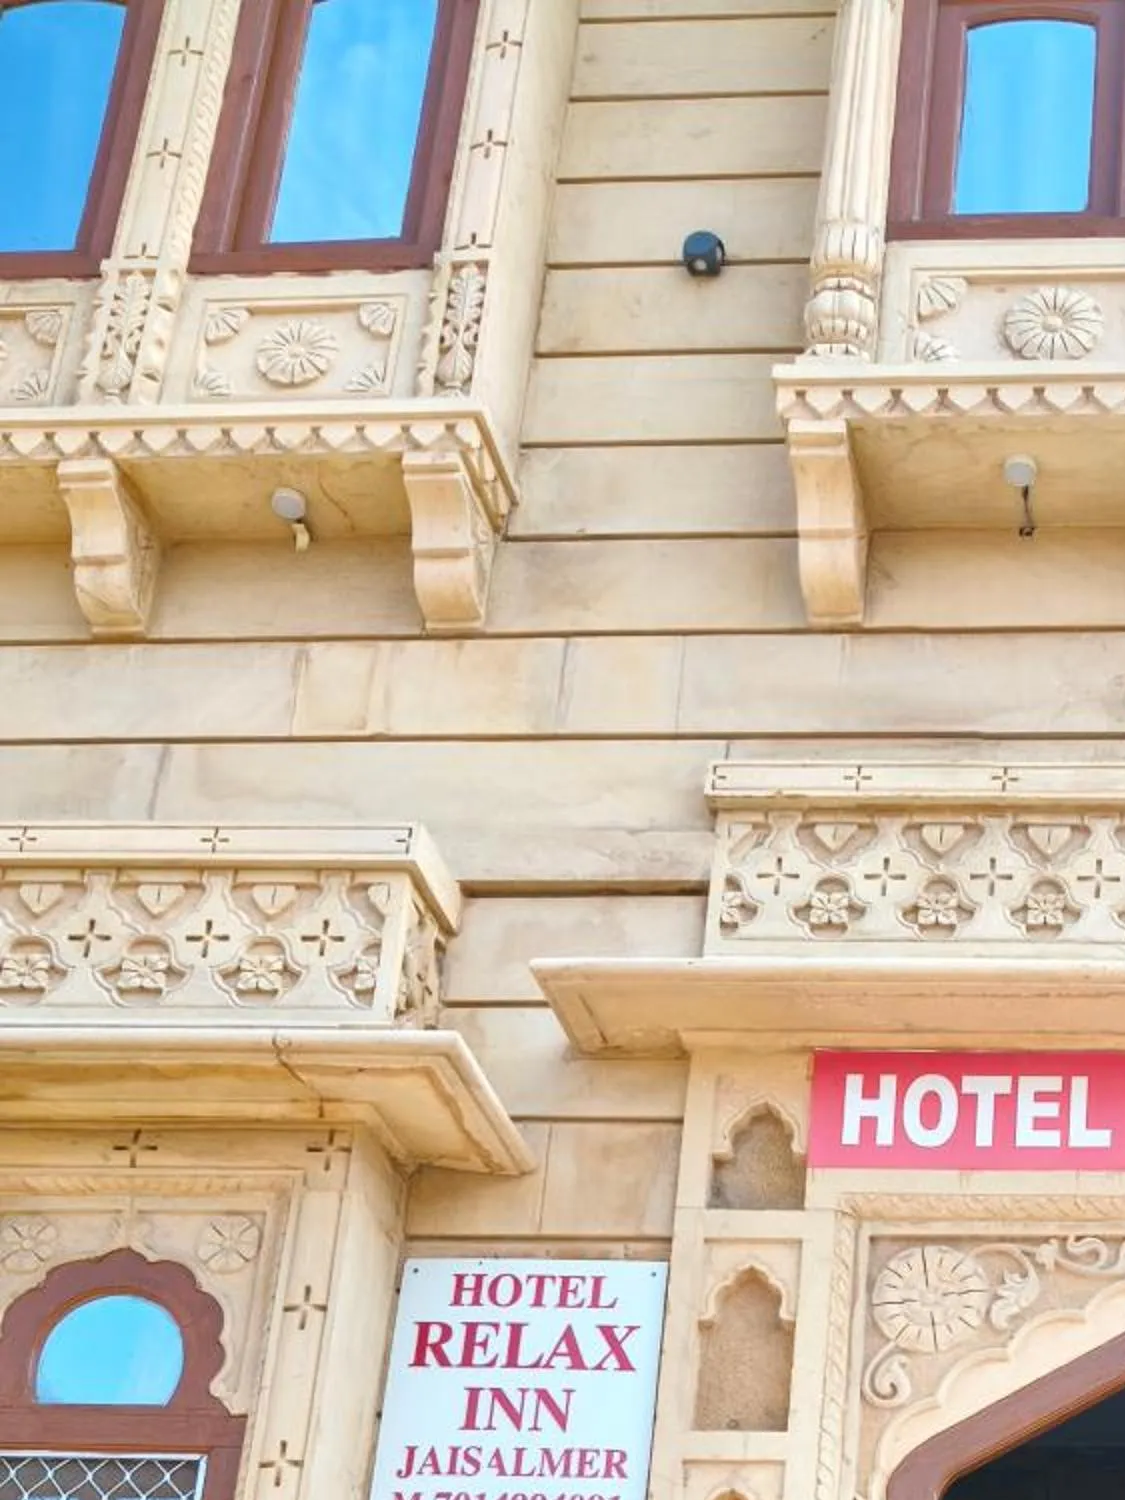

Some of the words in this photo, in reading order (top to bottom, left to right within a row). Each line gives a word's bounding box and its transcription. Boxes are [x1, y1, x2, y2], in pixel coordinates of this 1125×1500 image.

[841, 1074, 1114, 1150] HOTEL
[449, 1273, 617, 1308] HOTEL
[408, 1321, 640, 1372] RELAX
[459, 1387, 575, 1432] INN
[396, 1446, 627, 1479] JAISALMER
